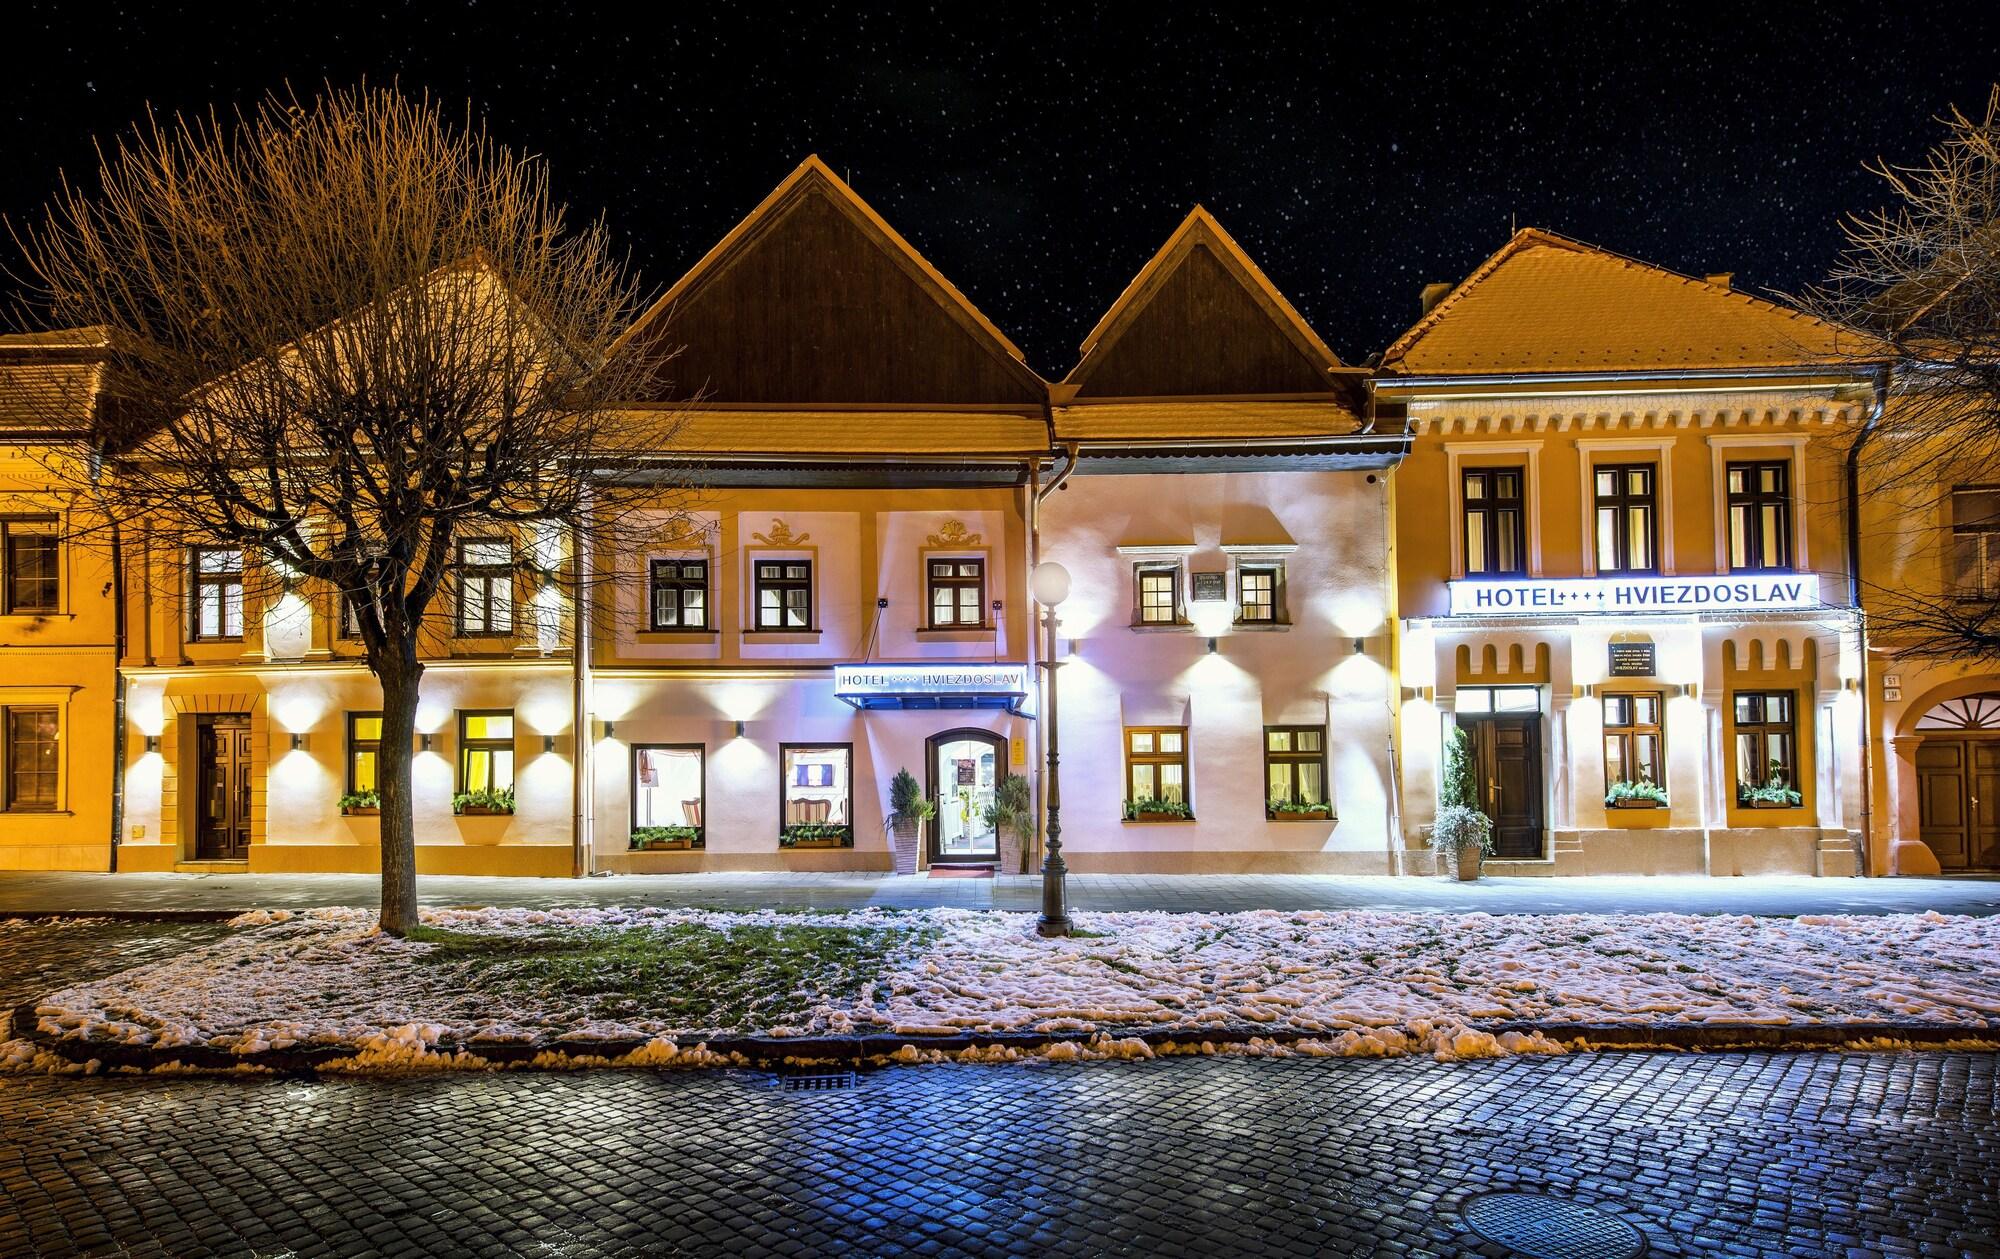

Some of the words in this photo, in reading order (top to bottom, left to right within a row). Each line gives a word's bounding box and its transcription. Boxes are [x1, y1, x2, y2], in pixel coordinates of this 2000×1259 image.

[1476, 587, 1563, 607] HOTEL
[1615, 583, 1802, 605] HVIEZDOSLAV
[842, 674, 889, 686] HOTEL
[922, 673, 1019, 686] HVIEZDOSLAV
